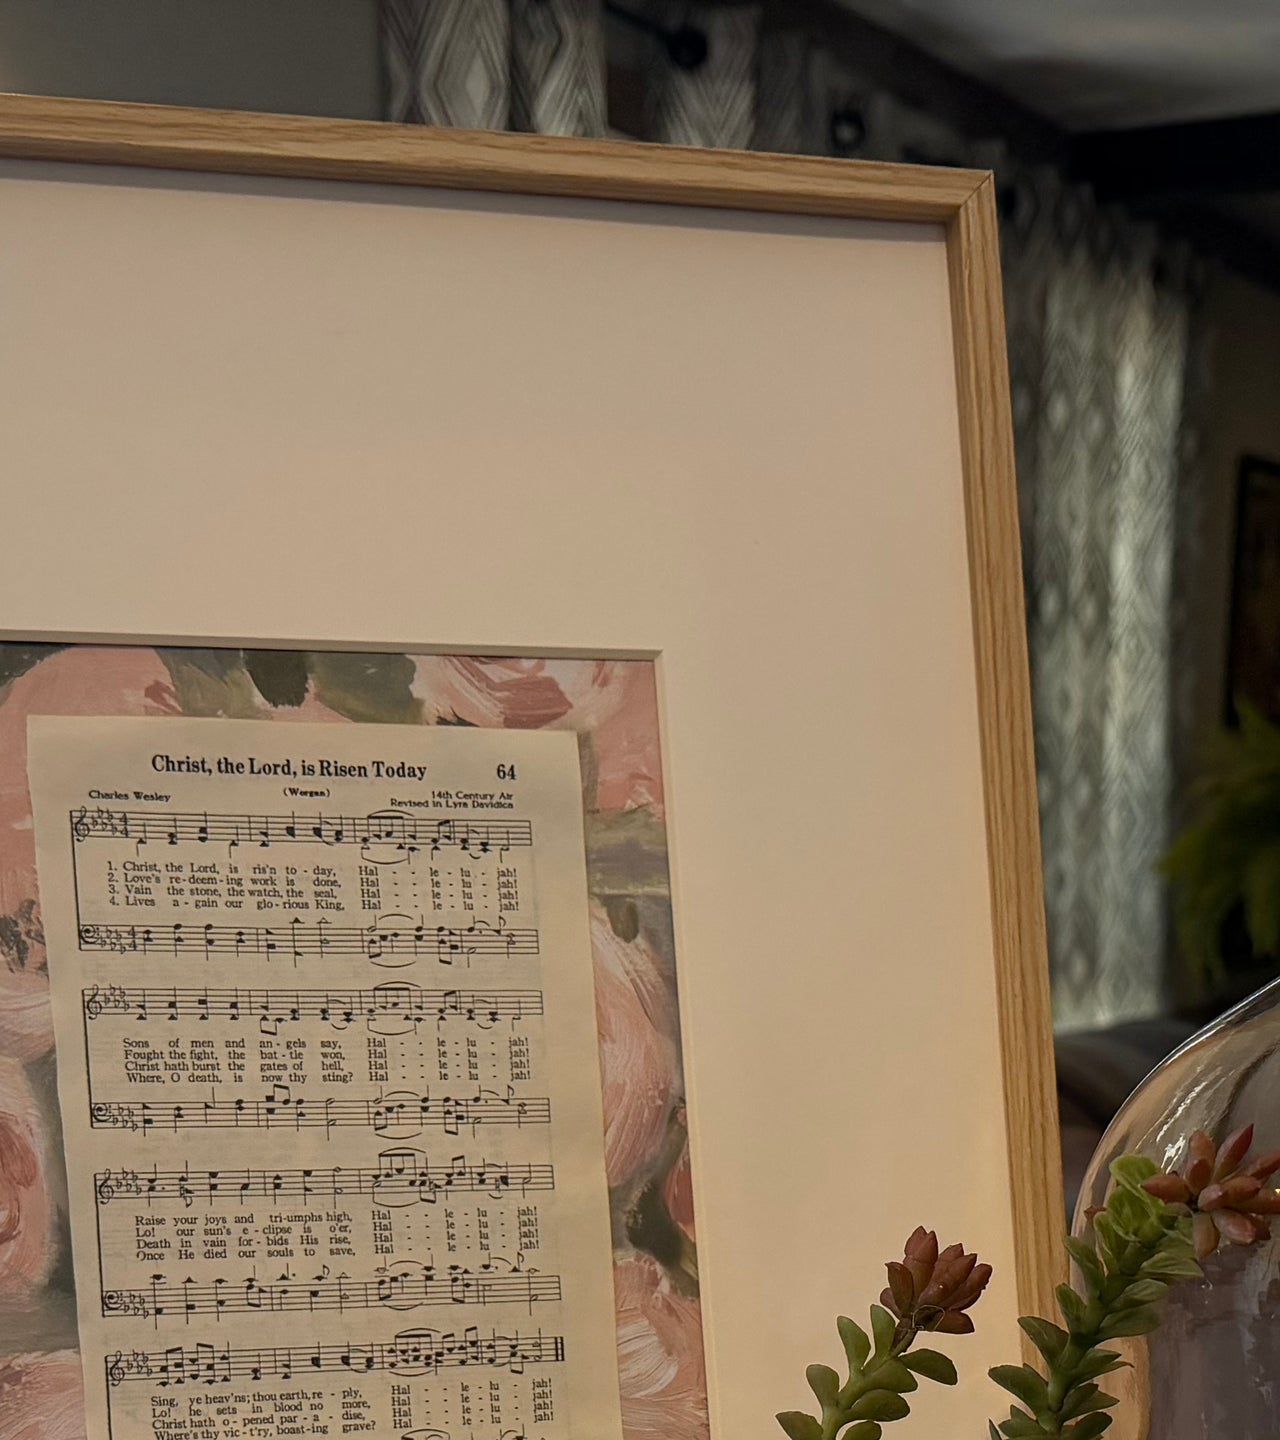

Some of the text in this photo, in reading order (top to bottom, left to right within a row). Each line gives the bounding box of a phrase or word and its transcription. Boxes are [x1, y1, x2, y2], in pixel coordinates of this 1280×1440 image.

[152, 754, 427, 781] Christ, the Lord, is Risen Today
[497, 764, 517, 780] 64
[89, 790, 171, 802] Charles Wesley
[432, 791, 452, 799] 14th
[456, 791, 495, 800] Century
[390, 799, 429, 808] Revised
[108, 861, 118, 871] 1.
[123, 861, 161, 873] Christ,
[165, 862, 183, 872] the
[191, 863, 220, 874] Lord,
[229, 864, 239, 873] is
[253, 864, 276, 875] ris'n
[108, 873, 118, 883] 2.
[124, 873, 161, 884] Love's
[251, 876, 277, 886] work
[286, 877, 295, 886] is
[313, 877, 341, 888] done,
[109, 884, 337, 899] 3. Vain the stone, the watch, the seal,
[110, 895, 120, 905] 4.
[125, 896, 155, 907] Lives
[225, 900, 243, 909] our
[315, 900, 344, 911] King,
[123, 1038, 150, 1048] Sons
[169, 1038, 180, 1048] of
[191, 1040, 214, 1048] men
[225, 1038, 245, 1049] and
[321, 1040, 341, 1050] say,
[124, 1050, 164, 1062] Fought
[169, 1050, 186, 1060] the
[190, 1051, 218, 1062] fight,
[228, 1050, 246, 1059] the
[321, 1052, 345, 1061] won,
[125, 1061, 344, 1073] Christ hath burst the gates of hell,
[127, 1072, 353, 1084] Where, O death, is now thy sting?
[136, 1216, 166, 1226] Raise
[174, 1217, 198, 1227] your
[205, 1215, 227, 1227] joys
[235, 1214, 254, 1224] and
[326, 1212, 352, 1225] high,
[136, 1228, 155, 1237] Lo!
[176, 1228, 195, 1236] our
[204, 1226, 231, 1236] sun's
[303, 1224, 311, 1233] is
[330, 1223, 352, 1234] o'er,
[137, 1239, 171, 1249] Death
[181, 1238, 192, 1248] in
[203, 1238, 226, 1247] vain
[301, 1235, 318, 1245] His
[330, 1235, 351, 1246] rise,
[136, 1247, 356, 1261] Once He died our souls to save,
[151, 1396, 179, 1408] Sing,
[189, 1397, 202, 1406] ye
[253, 1392, 277, 1402] thou
[280, 1390, 310, 1401] earth,
[152, 1401, 370, 1418] Lo! he sets in blood no more,
[152, 1419, 188, 1430] Christ
[190, 1417, 215, 1428] hath
[154, 1430, 199, 1440] Where's
[201, 1428, 219, 1440] thy
[342, 1420, 376, 1433] grave?
